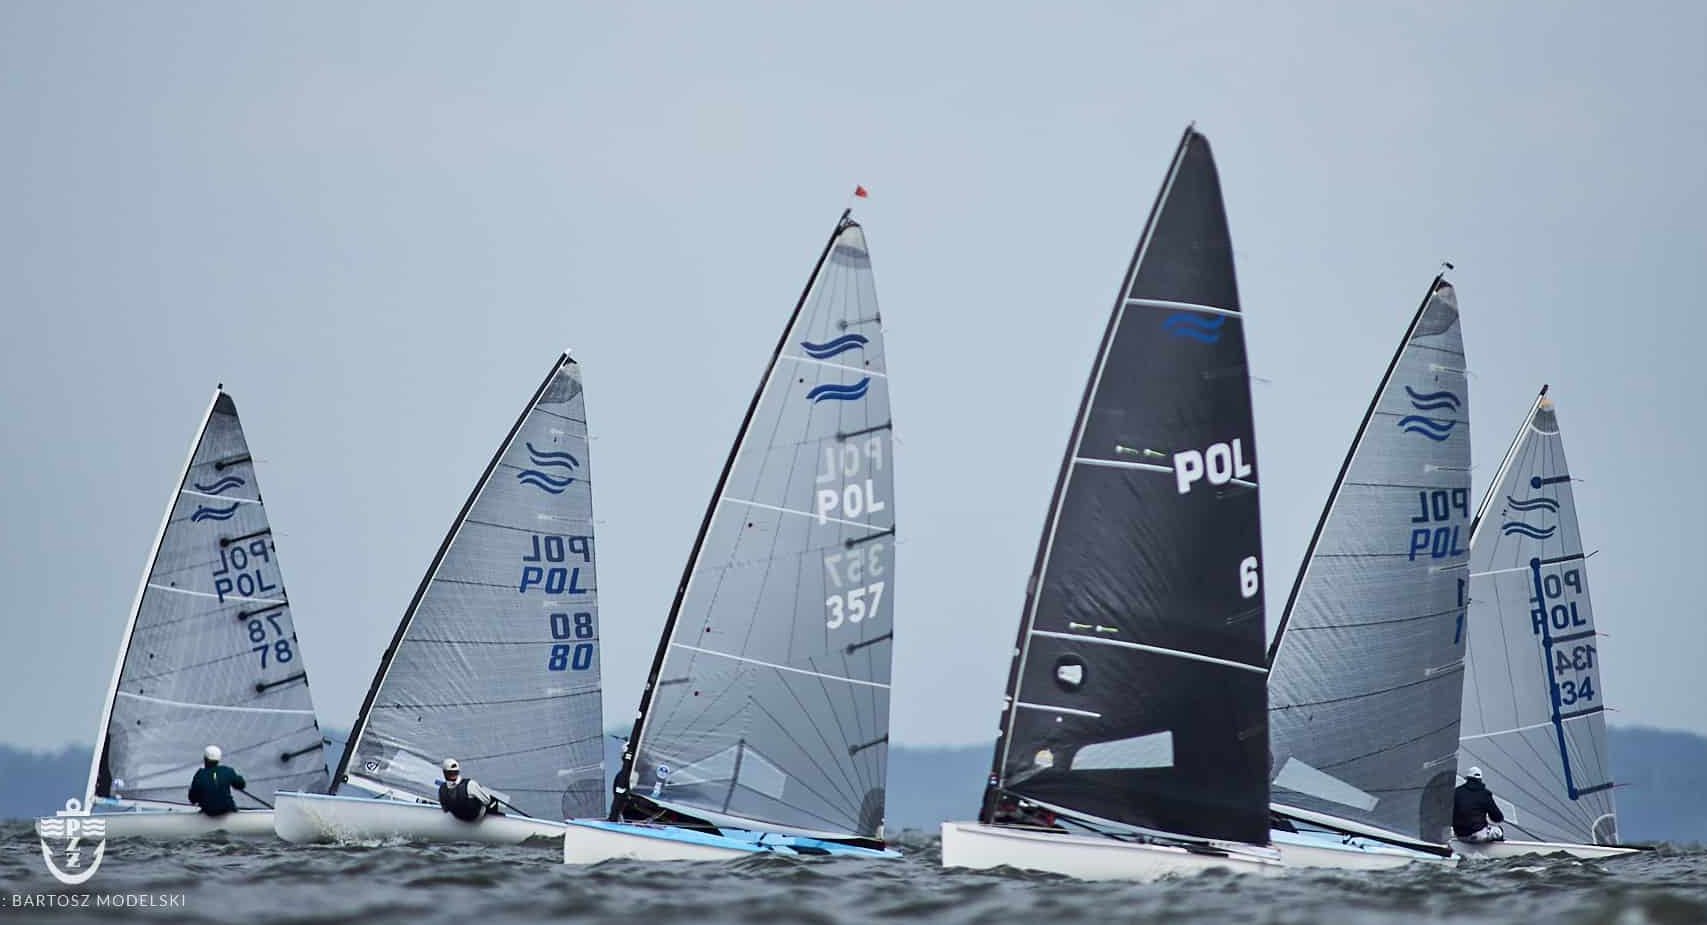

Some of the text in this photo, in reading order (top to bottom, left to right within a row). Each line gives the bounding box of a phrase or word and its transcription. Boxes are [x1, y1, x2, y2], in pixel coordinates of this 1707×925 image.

[1174, 438, 1252, 494] POL
[816, 479, 885, 525] POL
[1408, 525, 1467, 561] POL
[215, 569, 276, 603] POL
[520, 566, 587, 594] POL
[1240, 556, 1258, 598] 6
[826, 581, 885, 629] 357
[1531, 602, 1586, 635] POL
[252, 640, 293, 669] 78
[548, 643, 593, 671] 80
